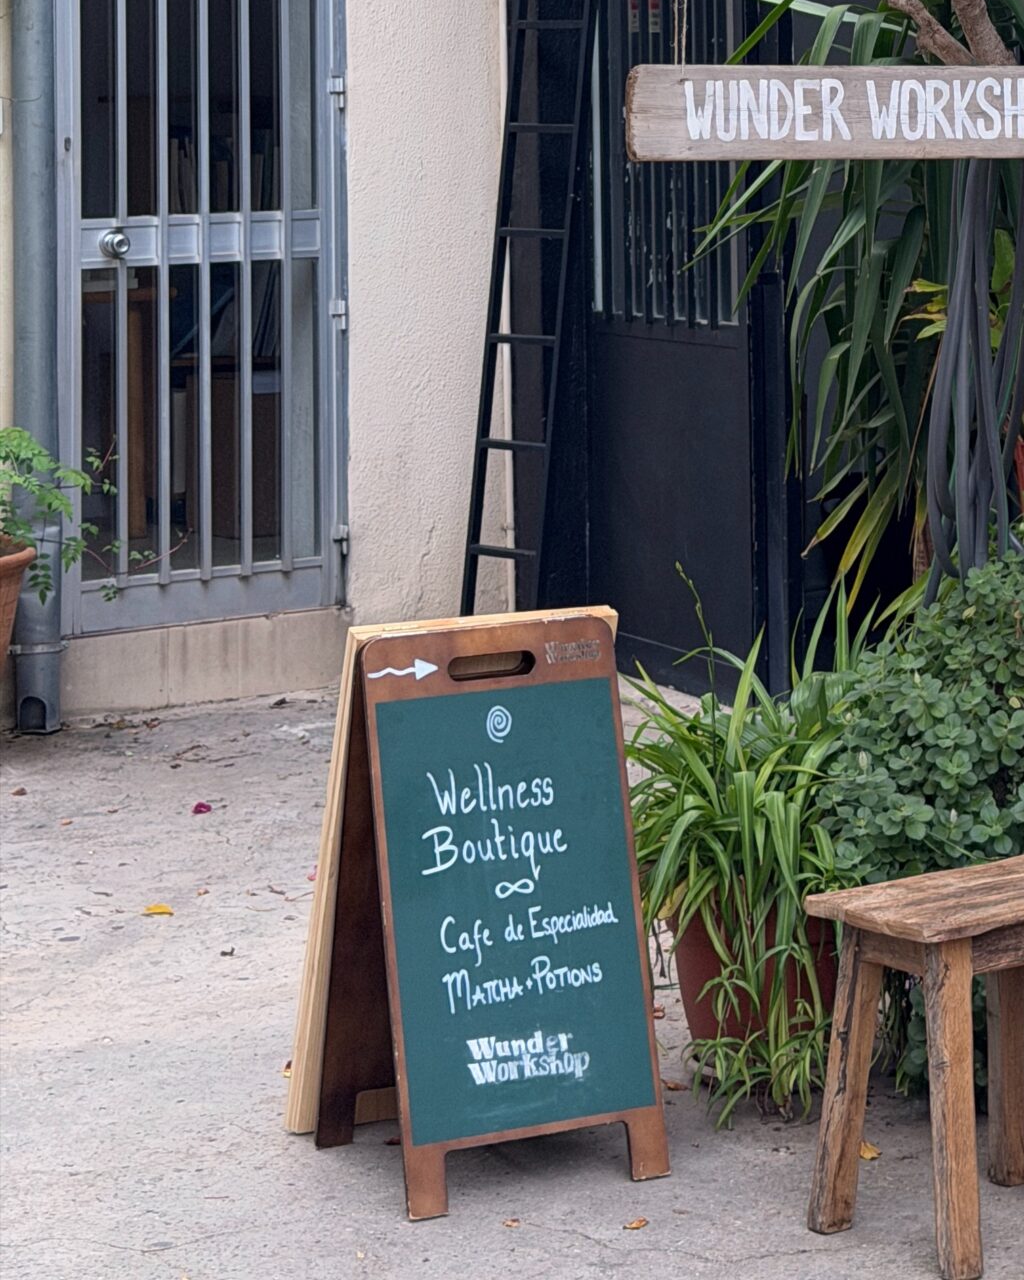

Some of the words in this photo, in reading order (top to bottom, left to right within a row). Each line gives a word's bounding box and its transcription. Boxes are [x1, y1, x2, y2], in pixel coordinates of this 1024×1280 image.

[684, 78, 853, 142] WUNDER
[426, 762, 555, 816] Wellness
[421, 818, 568, 881] Boutique
[440, 915, 494, 967] Cafe
[504, 914, 525, 943] de
[528, 901, 619, 945] Especialidad
[466, 1030, 574, 1061] Wunder
[467, 1050, 591, 1086] Workshop
